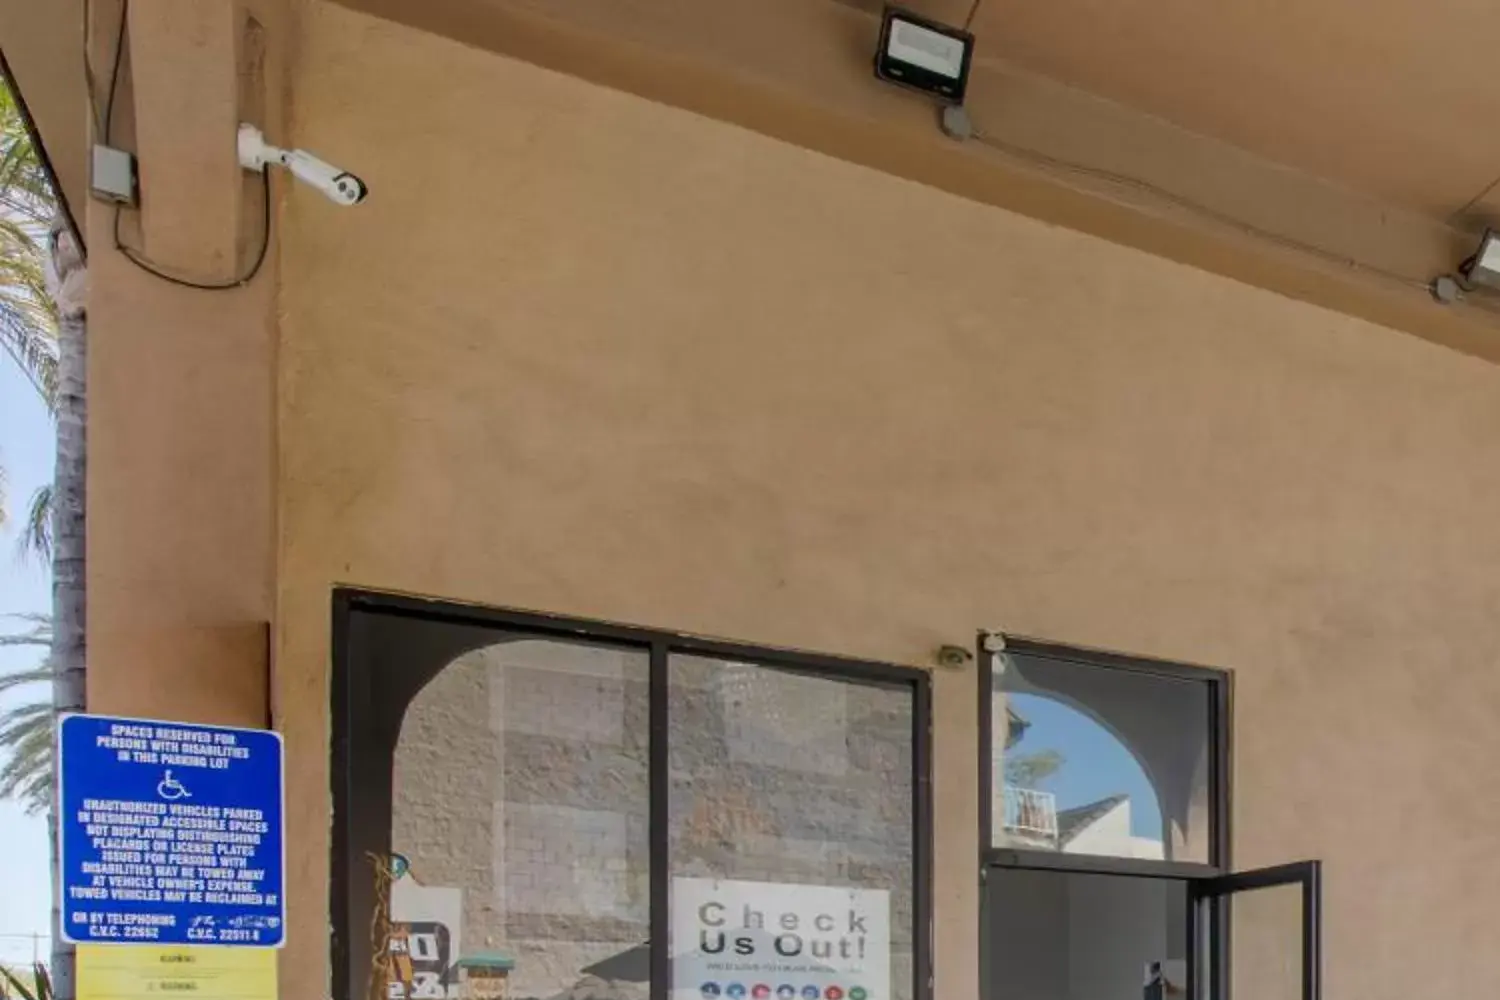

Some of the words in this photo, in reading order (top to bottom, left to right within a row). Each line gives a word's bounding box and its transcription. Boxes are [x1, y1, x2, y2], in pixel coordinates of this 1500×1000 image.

[96, 735, 148, 750] PERSONS
[151, 740, 179, 753] WITH
[133, 751, 158, 764] THIS
[210, 758, 229, 769] LOT
[169, 803, 220, 819] VEHICLES
[86, 824, 109, 837] NOT
[217, 844, 256, 858] PLATES
[108, 876, 155, 890] VEHICLE
[698, 900, 868, 935] Check
[700, 929, 756, 956] Us
[773, 932, 866, 960] Out!
